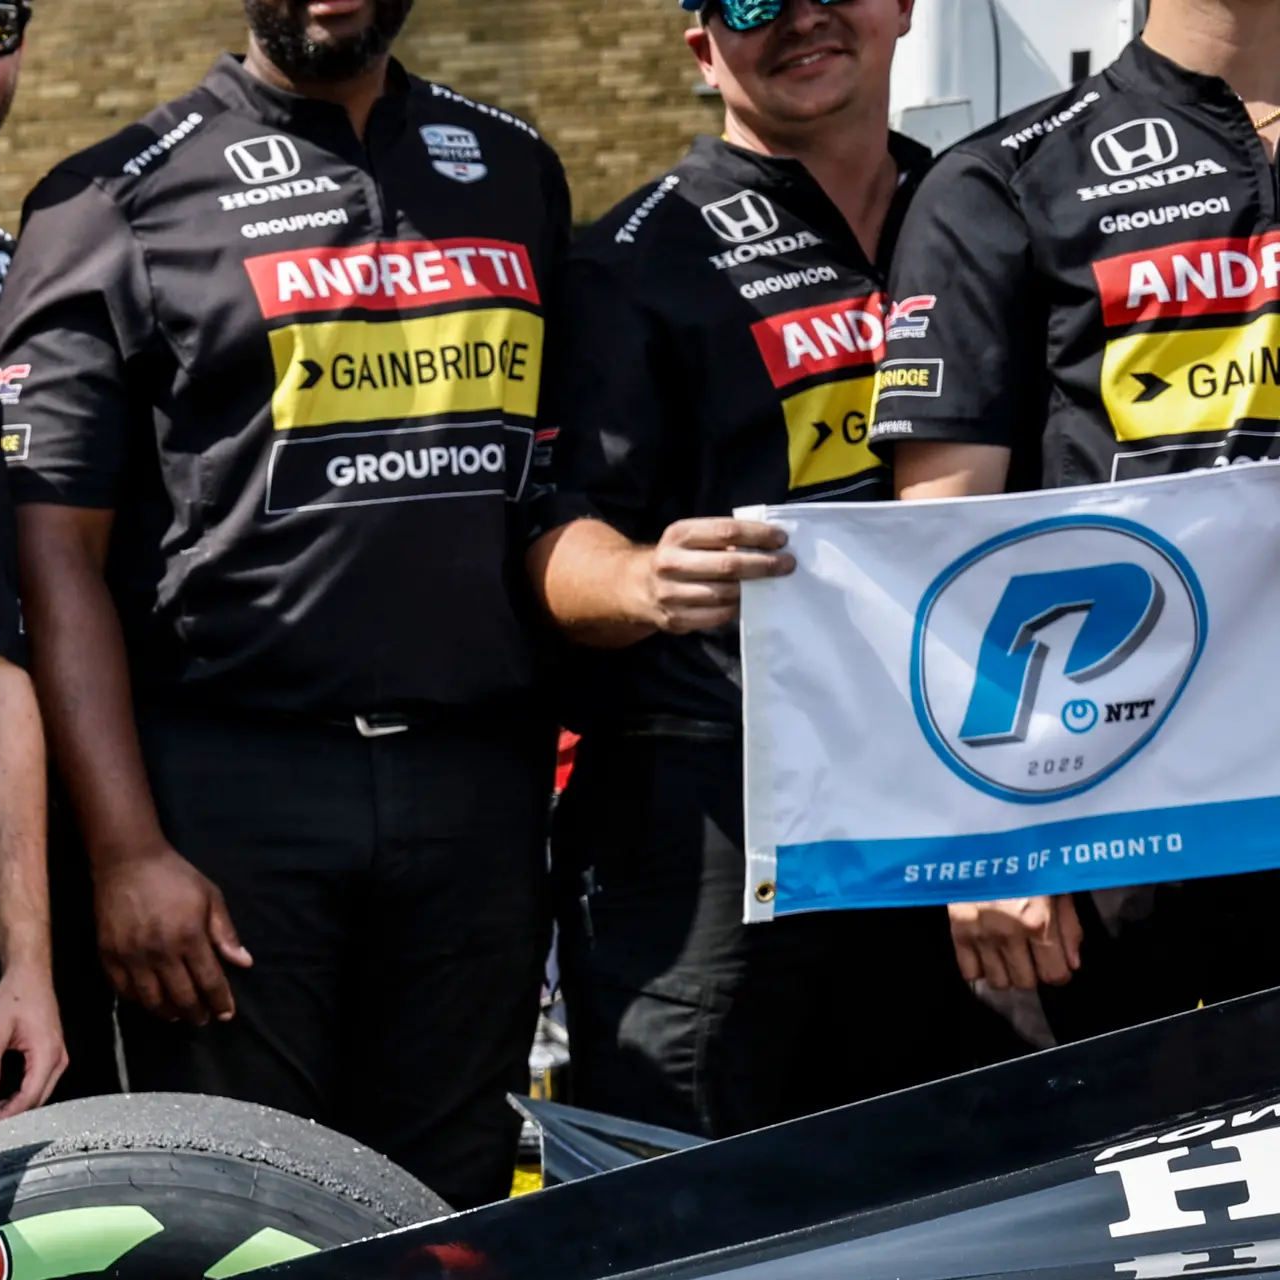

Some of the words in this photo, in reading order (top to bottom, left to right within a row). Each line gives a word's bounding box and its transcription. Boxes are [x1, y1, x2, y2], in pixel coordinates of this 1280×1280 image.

[1001, 90, 1100, 150] Firestone
[123, 111, 203, 176] Firestone
[217, 175, 341, 211] HONDA
[1077, 158, 1227, 201] HONDA
[615, 174, 680, 245] Firestone
[1098, 197, 1231, 234] GROUP1001
[277, 244, 527, 301] ANDRETTI
[709, 229, 822, 271] HONDA
[330, 342, 530, 391] GAINBRIDGE
[1104, 698, 1156, 725] NTT
[1027, 755, 1085, 777] 2025
[903, 856, 1021, 884] STREETS
[1026, 848, 1052, 873] OF
[1059, 832, 1184, 867] TORONTO
